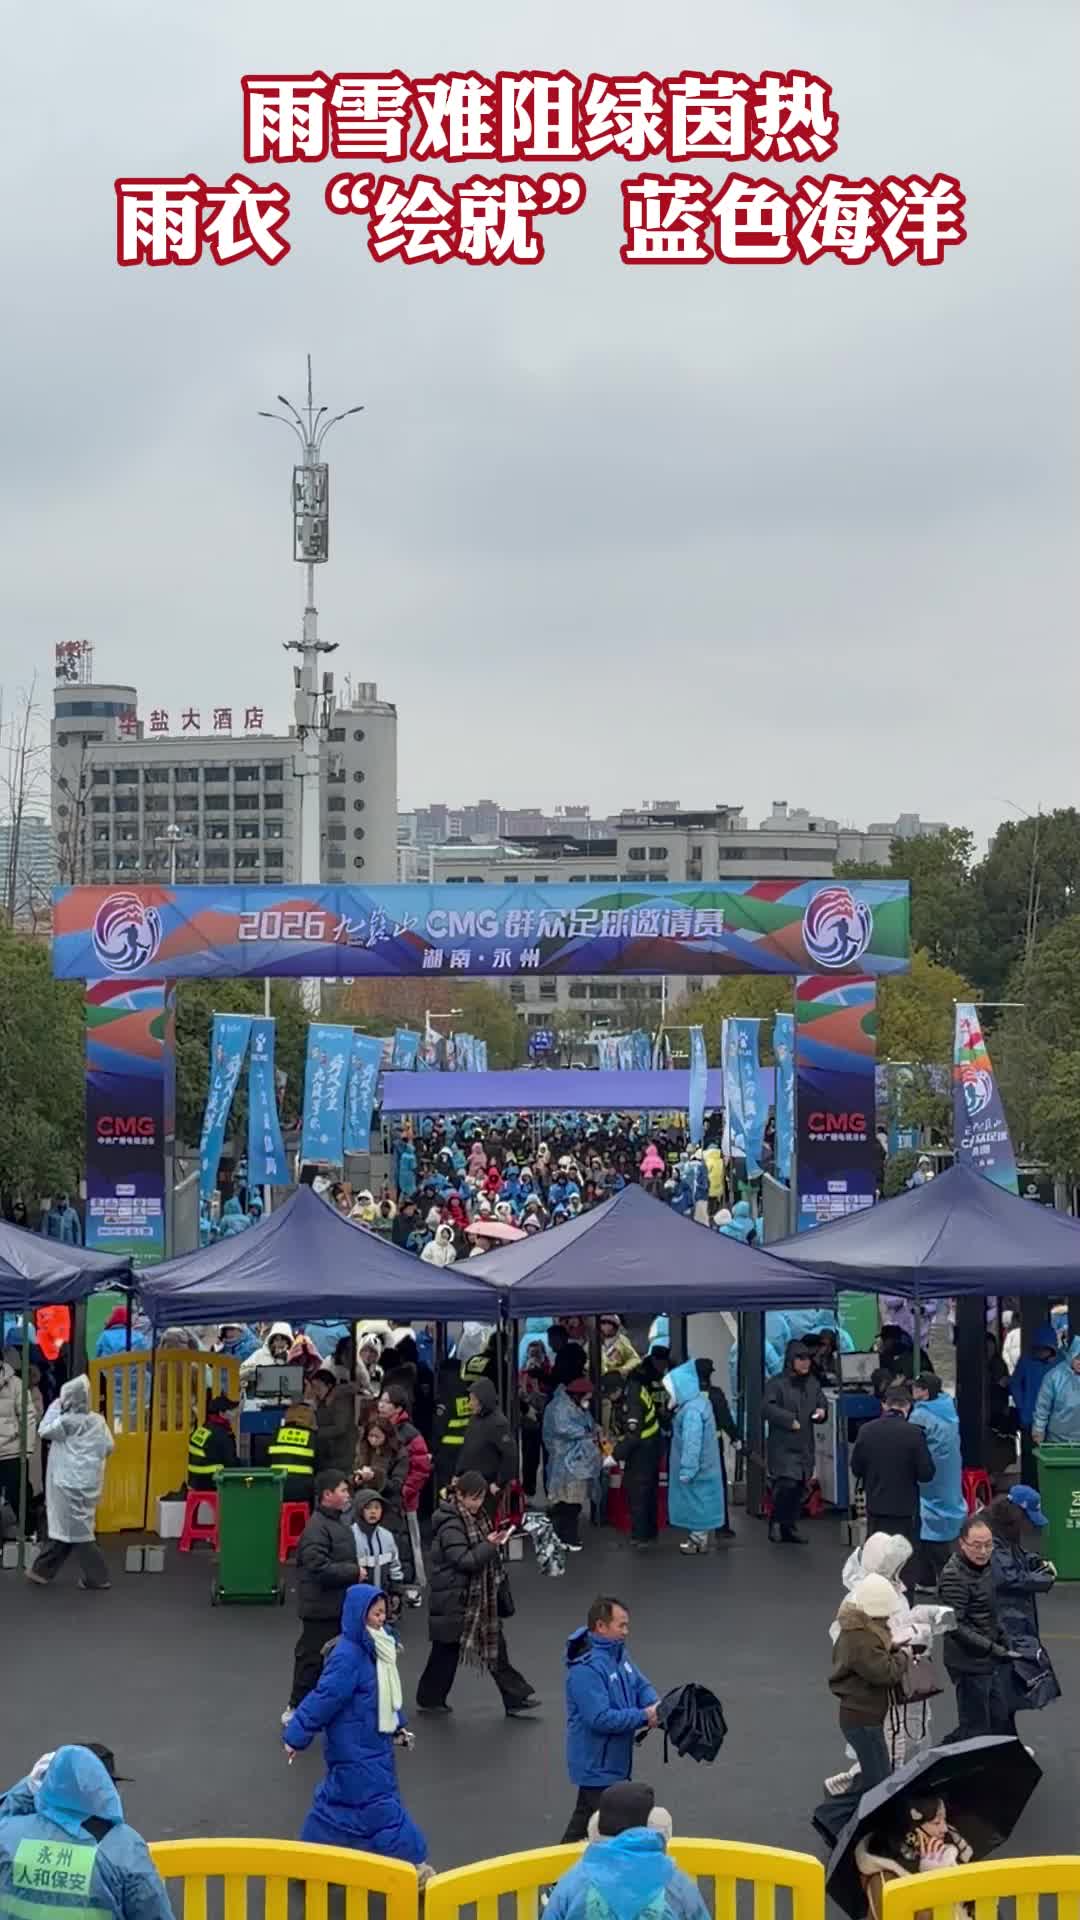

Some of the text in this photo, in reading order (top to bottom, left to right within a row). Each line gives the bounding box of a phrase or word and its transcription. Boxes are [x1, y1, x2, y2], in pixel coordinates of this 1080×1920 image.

[238, 911, 327, 940] 2026
[426, 910, 498, 938] CMG
[504, 908, 726, 938] 群众足球邀请赛
[96, 1116, 156, 1136] CMG
[807, 1112, 867, 1132] CMG
[36, 1845, 73, 1867] 永州
[17, 1864, 87, 1891] 人和保安
